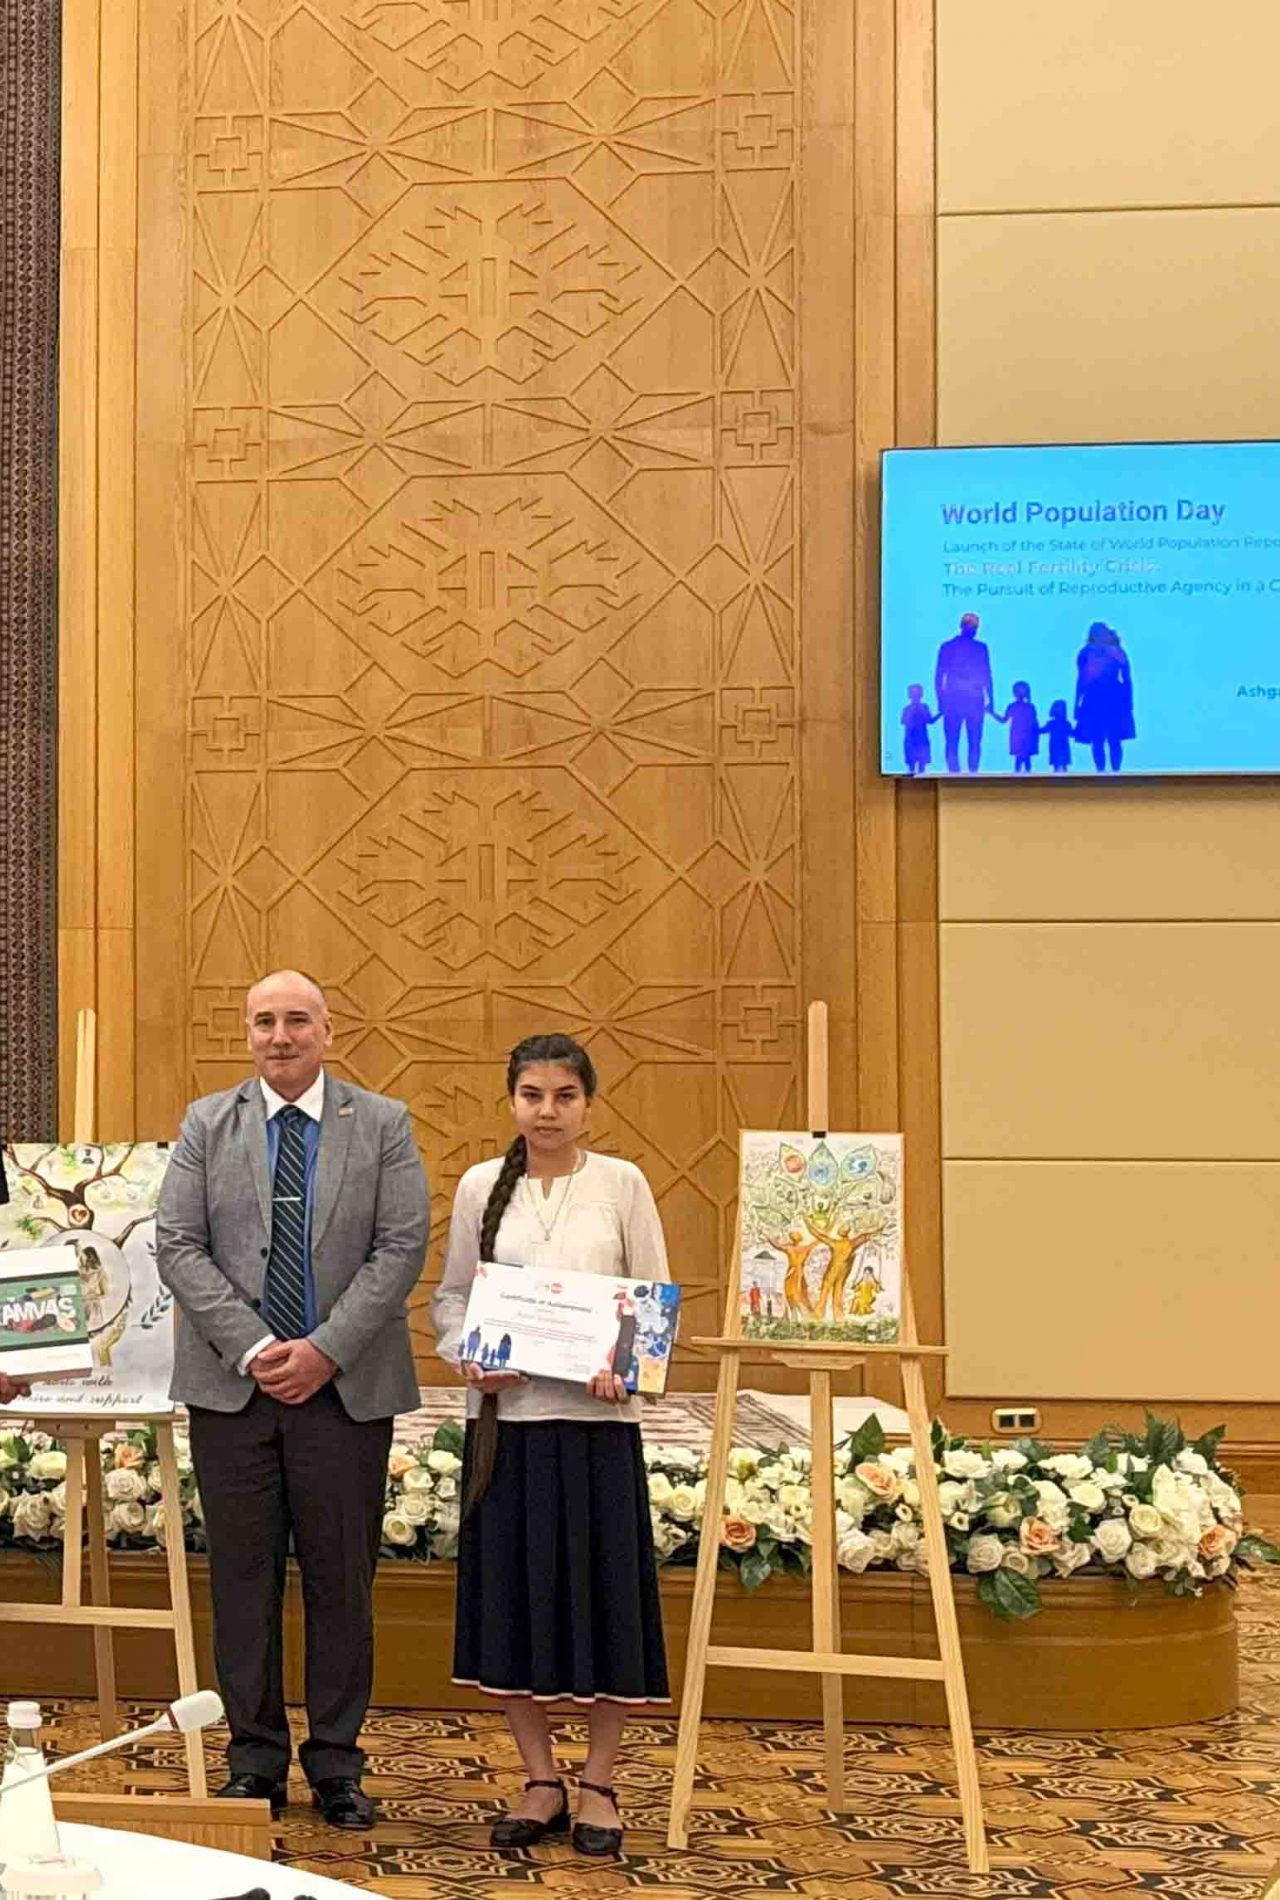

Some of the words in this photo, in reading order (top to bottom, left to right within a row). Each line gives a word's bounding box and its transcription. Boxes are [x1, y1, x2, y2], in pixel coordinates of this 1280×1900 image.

[941, 501, 1018, 525] World
[1026, 499, 1168, 529] Population
[1176, 499, 1226, 526] Day
[943, 539, 998, 554] Launch
[1001, 539, 1018, 551] of
[1020, 539, 1045, 551] the
[1048, 538, 1086, 551] State
[1107, 537, 1153, 550] World
[1158, 536, 1240, 551] Population
[942, 583, 972, 597] The
[976, 582, 1034, 597] Pursuit
[1038, 580, 1055, 595] of
[1058, 580, 1167, 597] Reproductive
[1170, 579, 1232, 596] Agency
[1236, 578, 1251, 592] in
